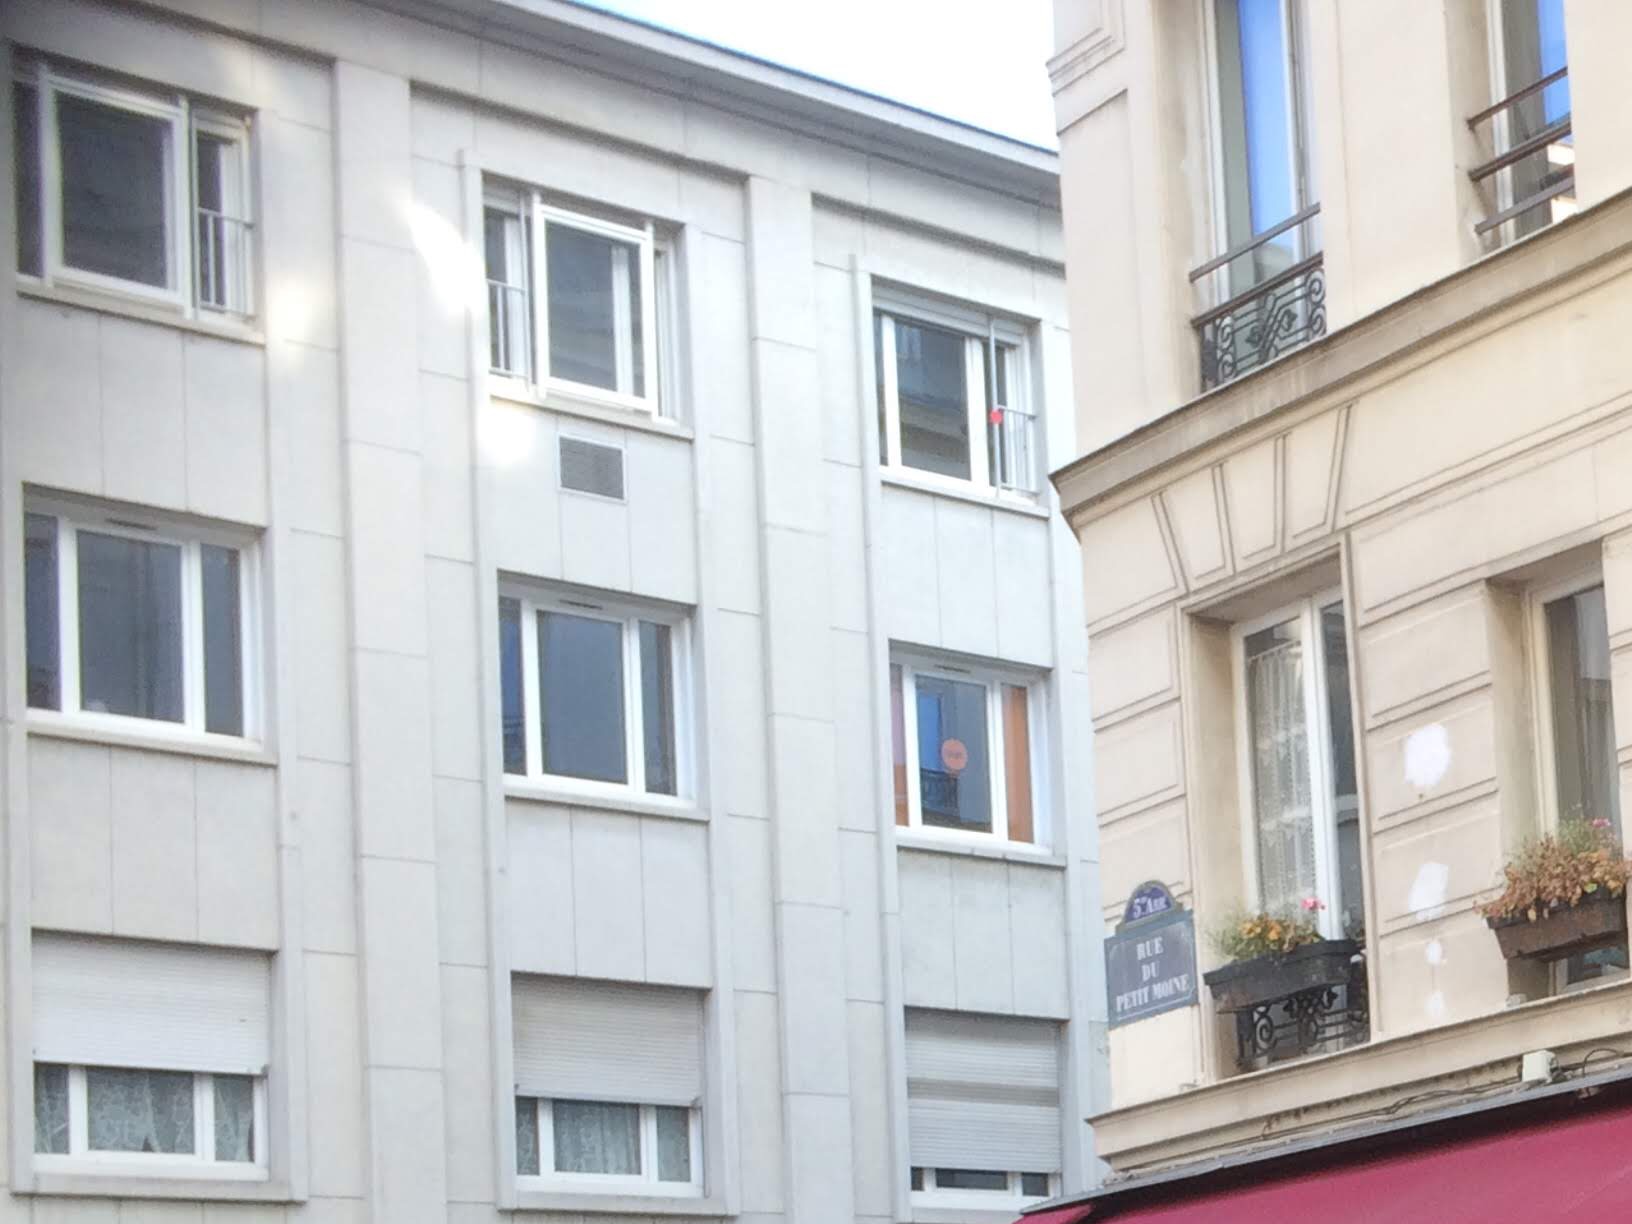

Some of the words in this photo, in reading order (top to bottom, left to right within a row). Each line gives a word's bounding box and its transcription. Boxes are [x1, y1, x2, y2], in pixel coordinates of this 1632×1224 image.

[1136, 937, 1164, 961] RUE
[1142, 962, 1159, 982] DU
[1116, 988, 1150, 1012] PETIT
[1152, 975, 1188, 1001] MOINE
